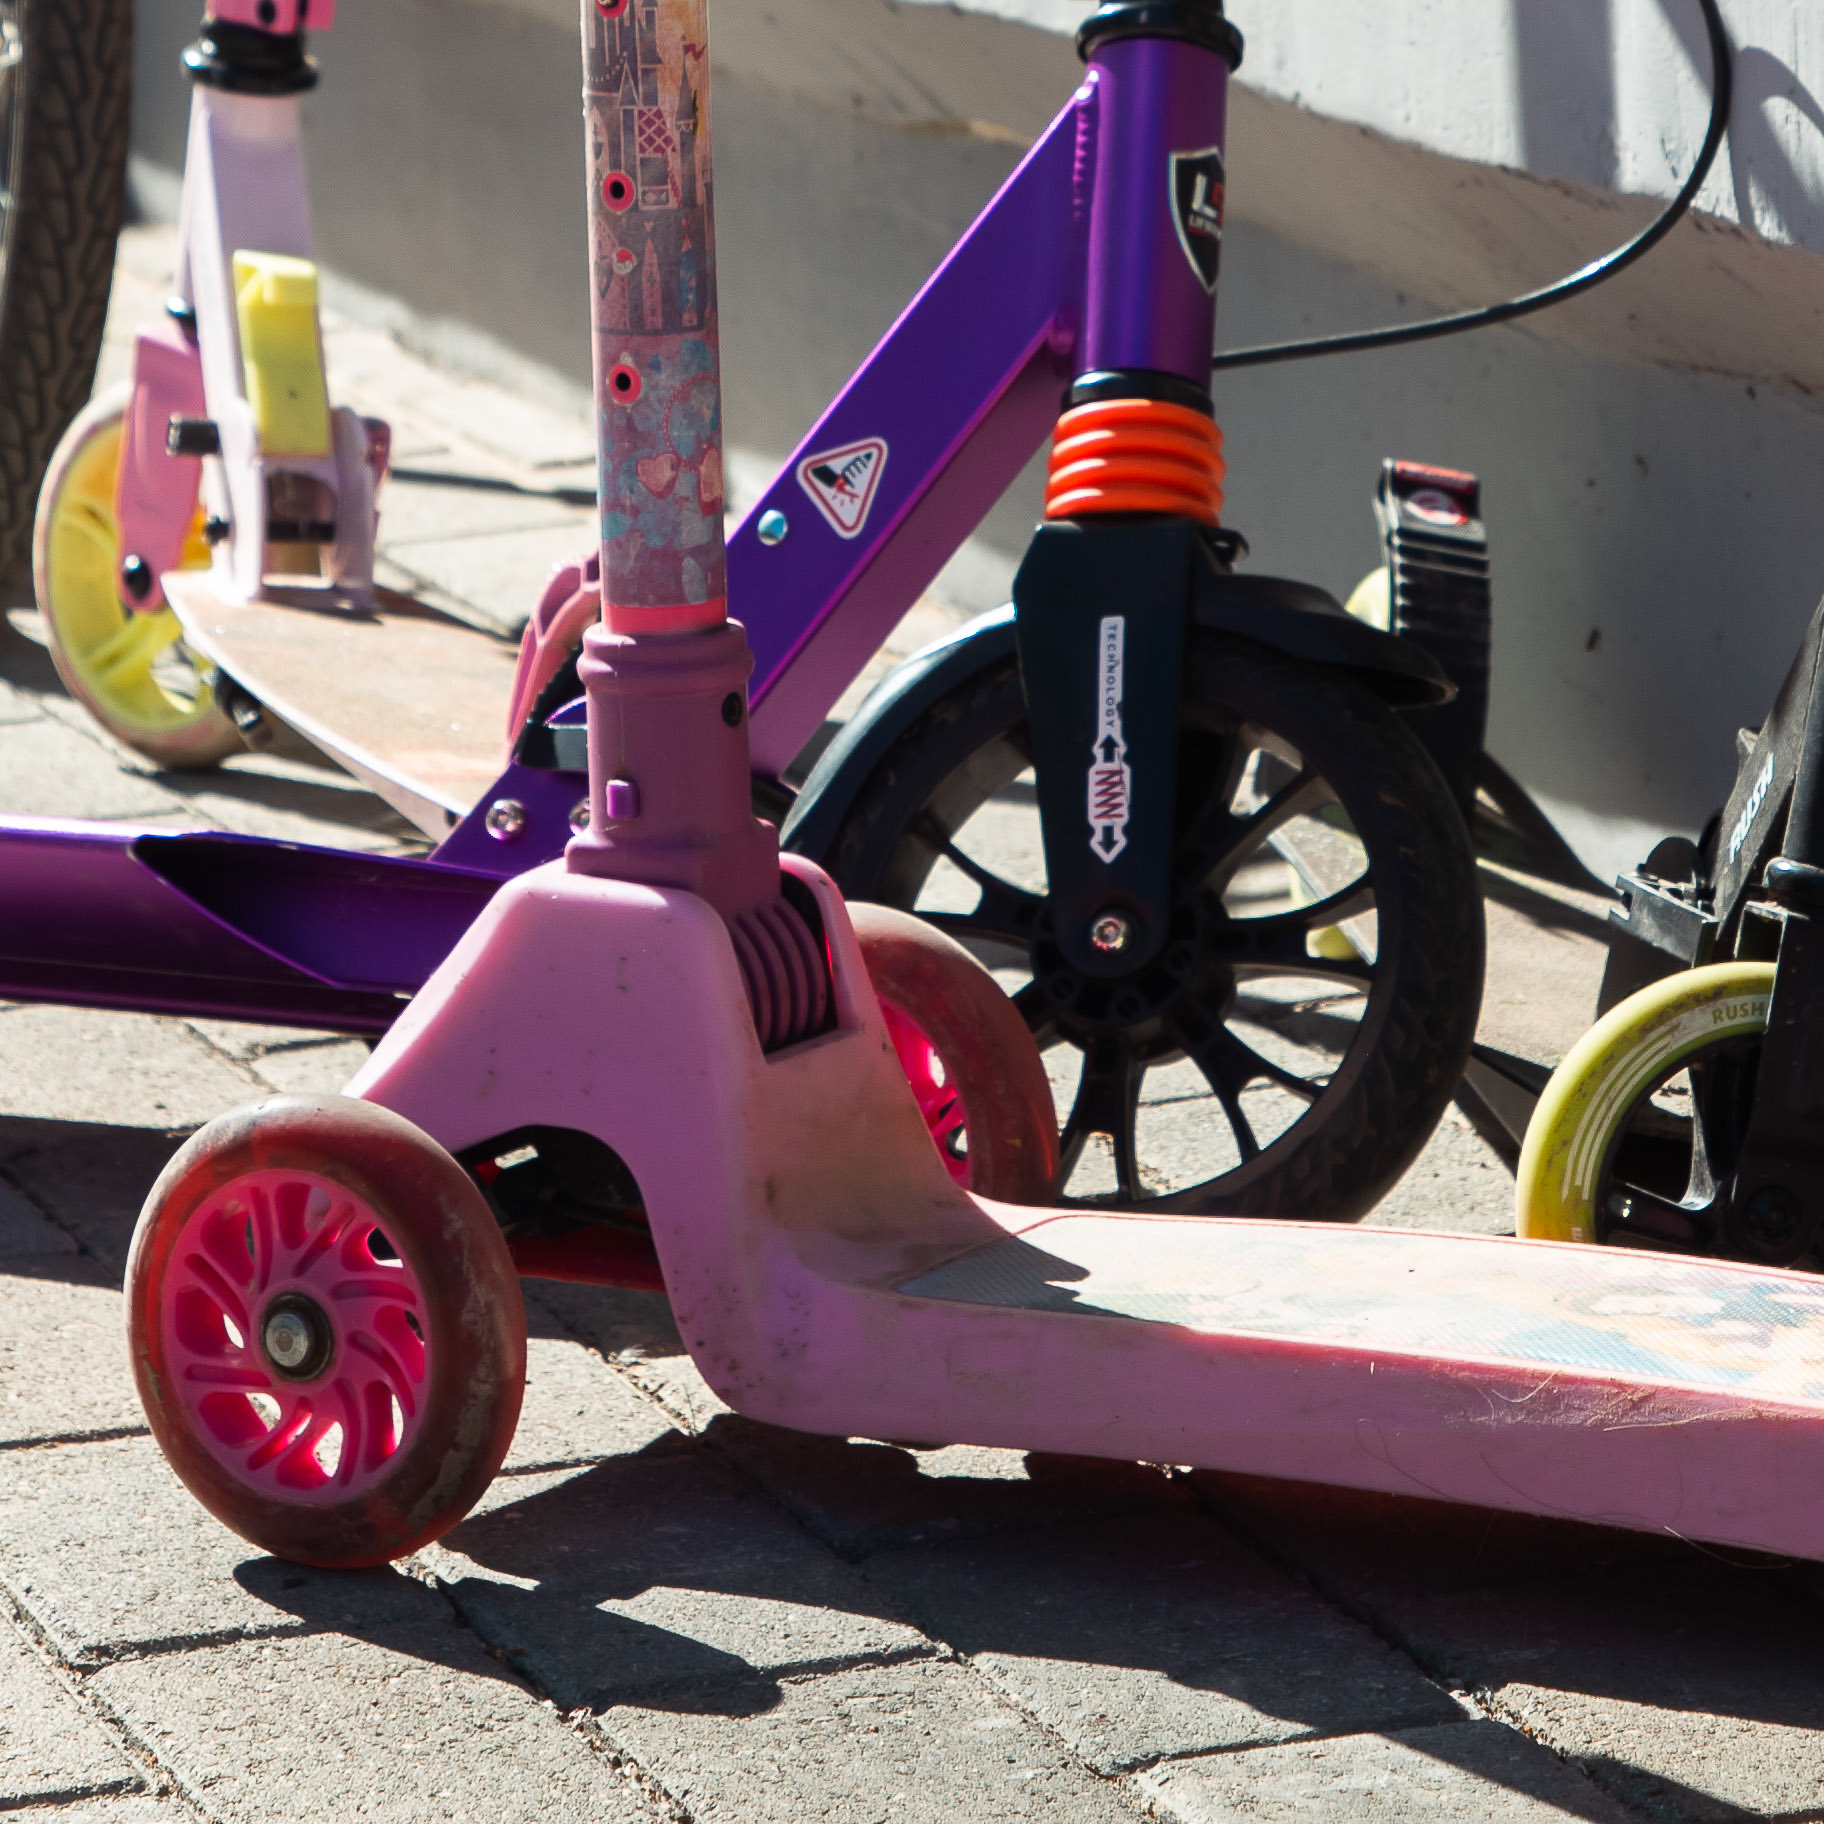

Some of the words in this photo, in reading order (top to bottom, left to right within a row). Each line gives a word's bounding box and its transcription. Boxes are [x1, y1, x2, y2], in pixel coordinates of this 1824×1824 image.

[1105, 624, 1118, 728] TECHNOLOGY
[1730, 752, 1774, 865] RUSH
[1711, 1001, 1764, 1024] RUSH
